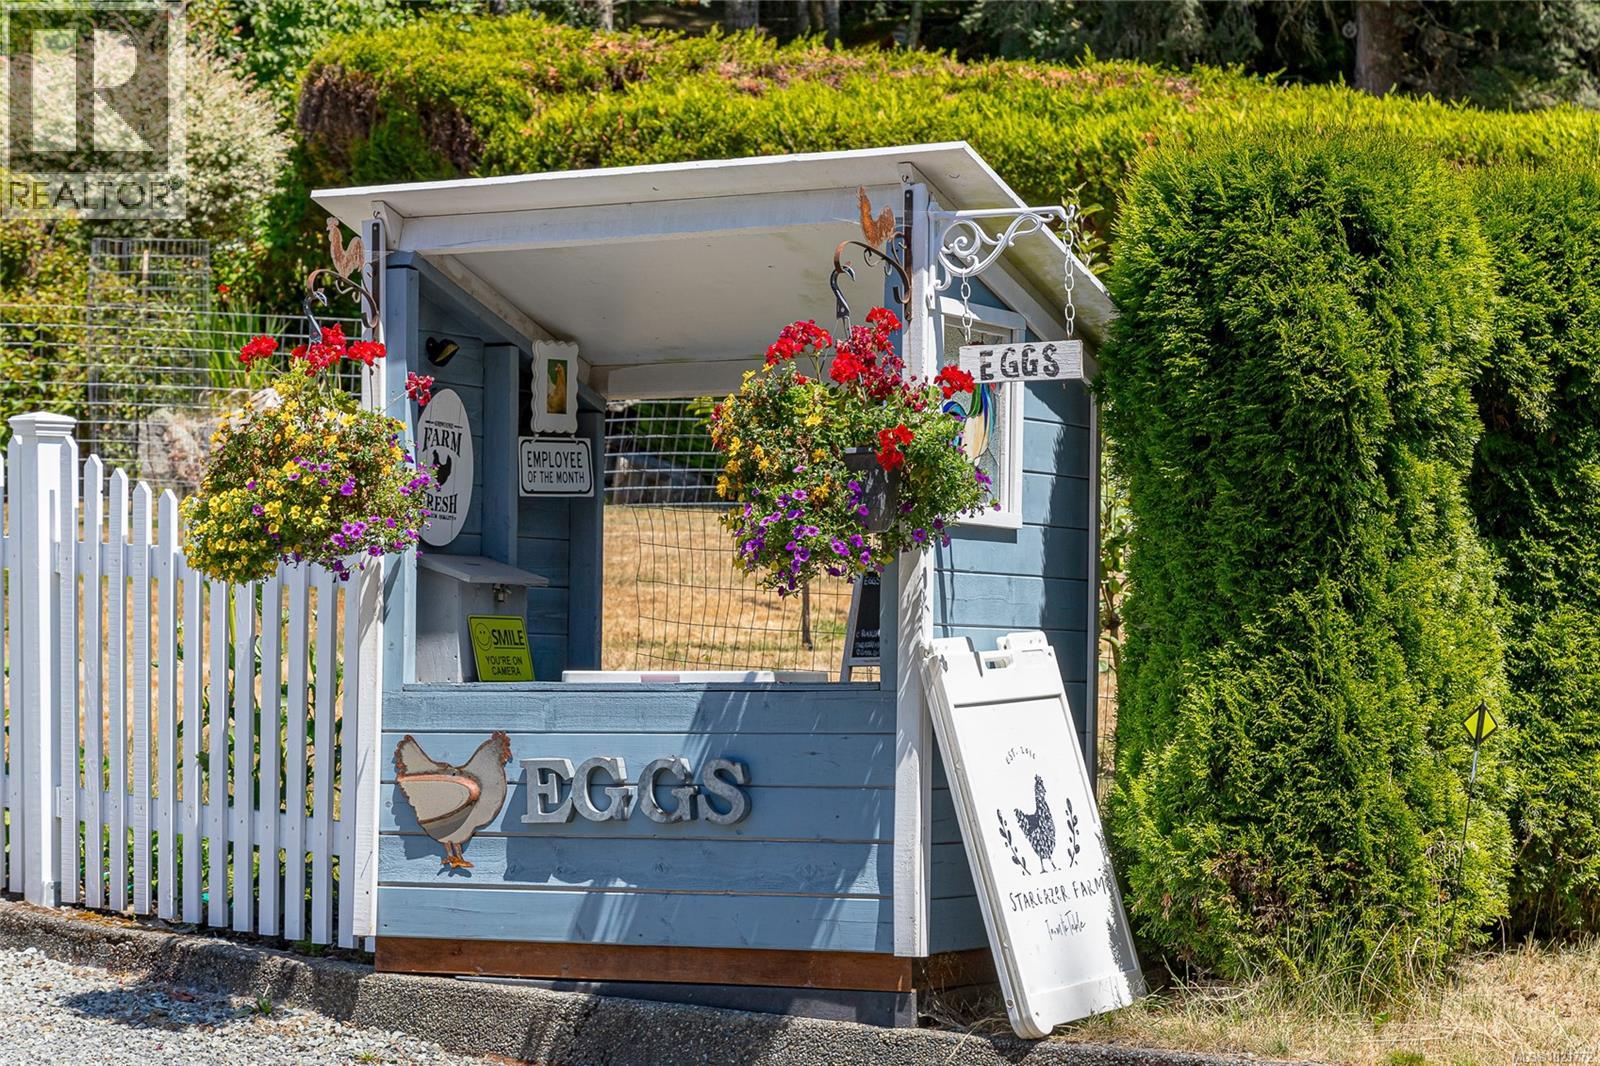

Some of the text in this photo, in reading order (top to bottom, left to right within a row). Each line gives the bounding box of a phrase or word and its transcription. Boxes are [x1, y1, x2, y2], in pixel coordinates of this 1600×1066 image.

[979, 343, 1060, 381] EGGS
[422, 426, 463, 458] FARM
[527, 450, 584, 469] EMPLOYEE
[527, 470, 585, 485] OF THE MONTH
[491, 629, 525, 646] SMILE
[512, 656, 523, 665] ON
[491, 666, 521, 675] CAMERA
[520, 756, 751, 825] EGGS
[1072, 876, 1107, 899] FARM
